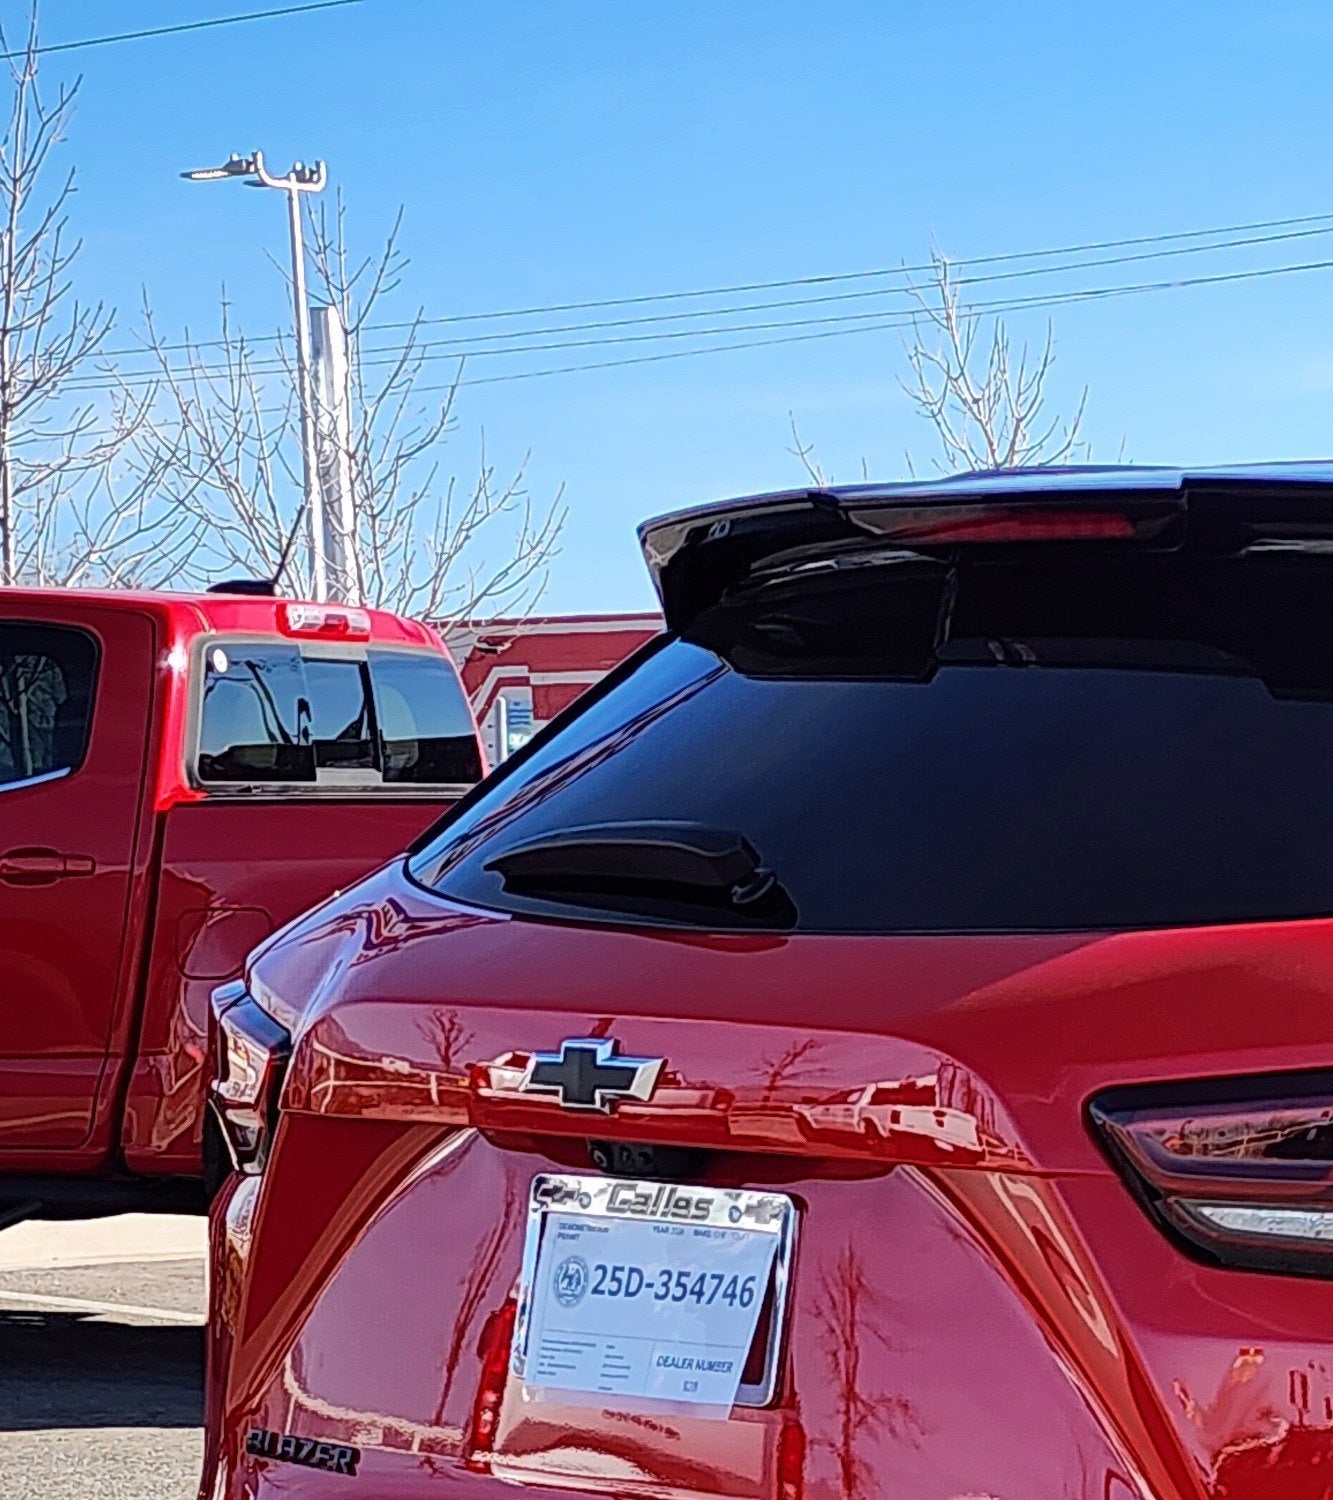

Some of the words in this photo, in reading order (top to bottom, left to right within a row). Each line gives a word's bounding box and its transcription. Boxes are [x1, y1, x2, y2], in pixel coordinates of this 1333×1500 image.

[591, 1264, 757, 1308] 25D-354746
[656, 1355, 694, 1370] DEALER
[695, 1358, 734, 1373] NUMBER
[246, 1427, 361, 1476] BLAZER
